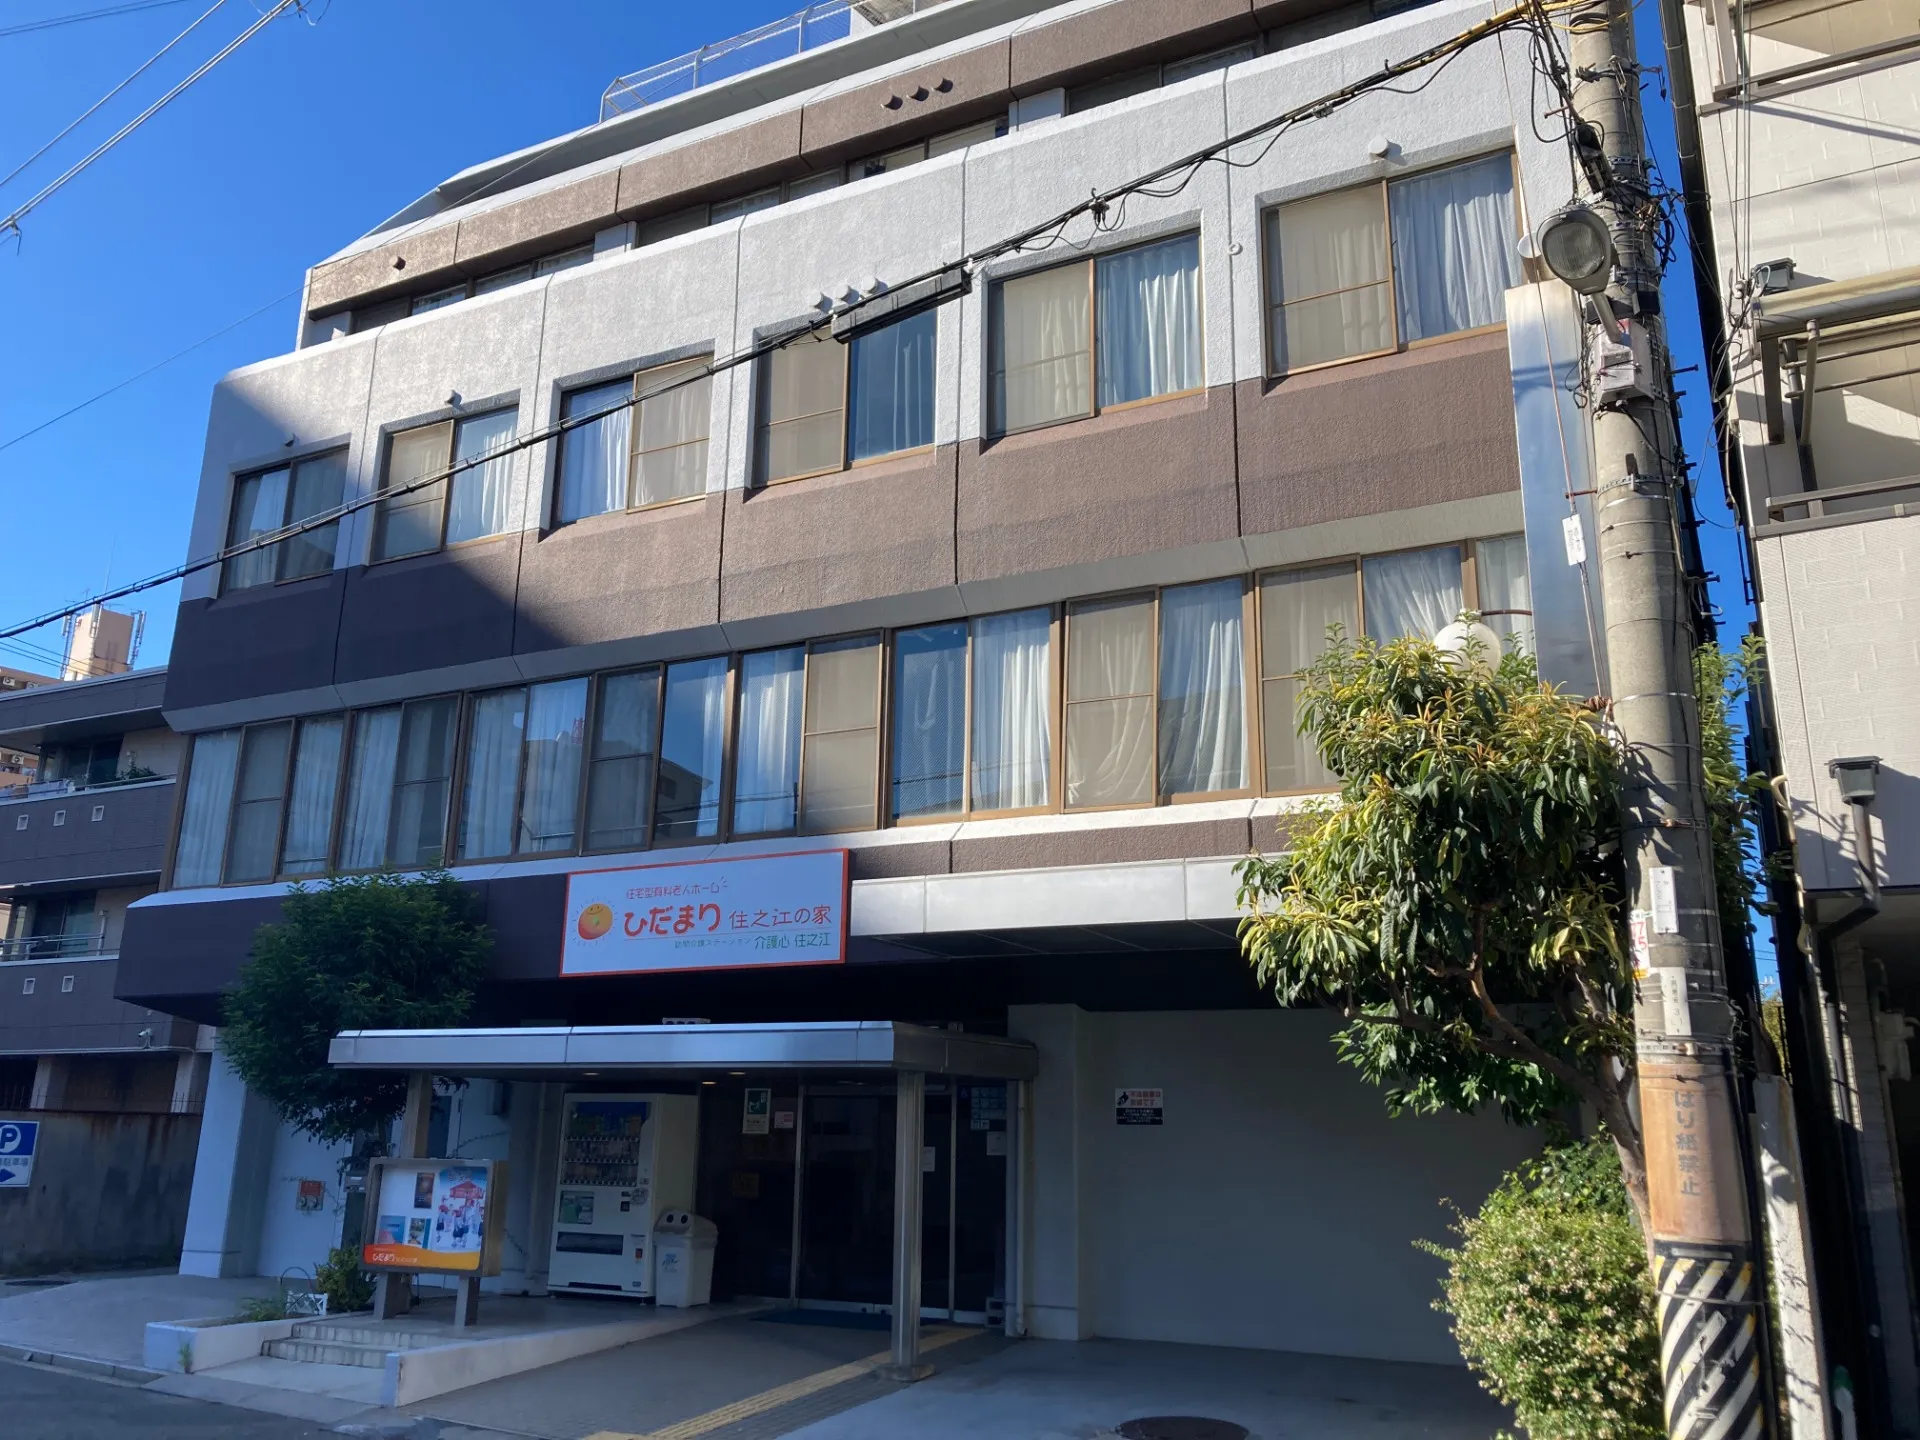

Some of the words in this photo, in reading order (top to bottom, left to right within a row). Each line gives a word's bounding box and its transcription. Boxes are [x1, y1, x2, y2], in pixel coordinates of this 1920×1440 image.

[626, 882, 720, 900] 住宅型有料老人ホーム
[624, 903, 721, 937] ひだまり
[729, 905, 832, 930] 住之江の家
[754, 934, 790, 950] 介護心
[794, 932, 831, 948] 住之江
[0, 1127, 18, 1150] P
[1674, 1091, 1701, 1196] はり紙禁止
